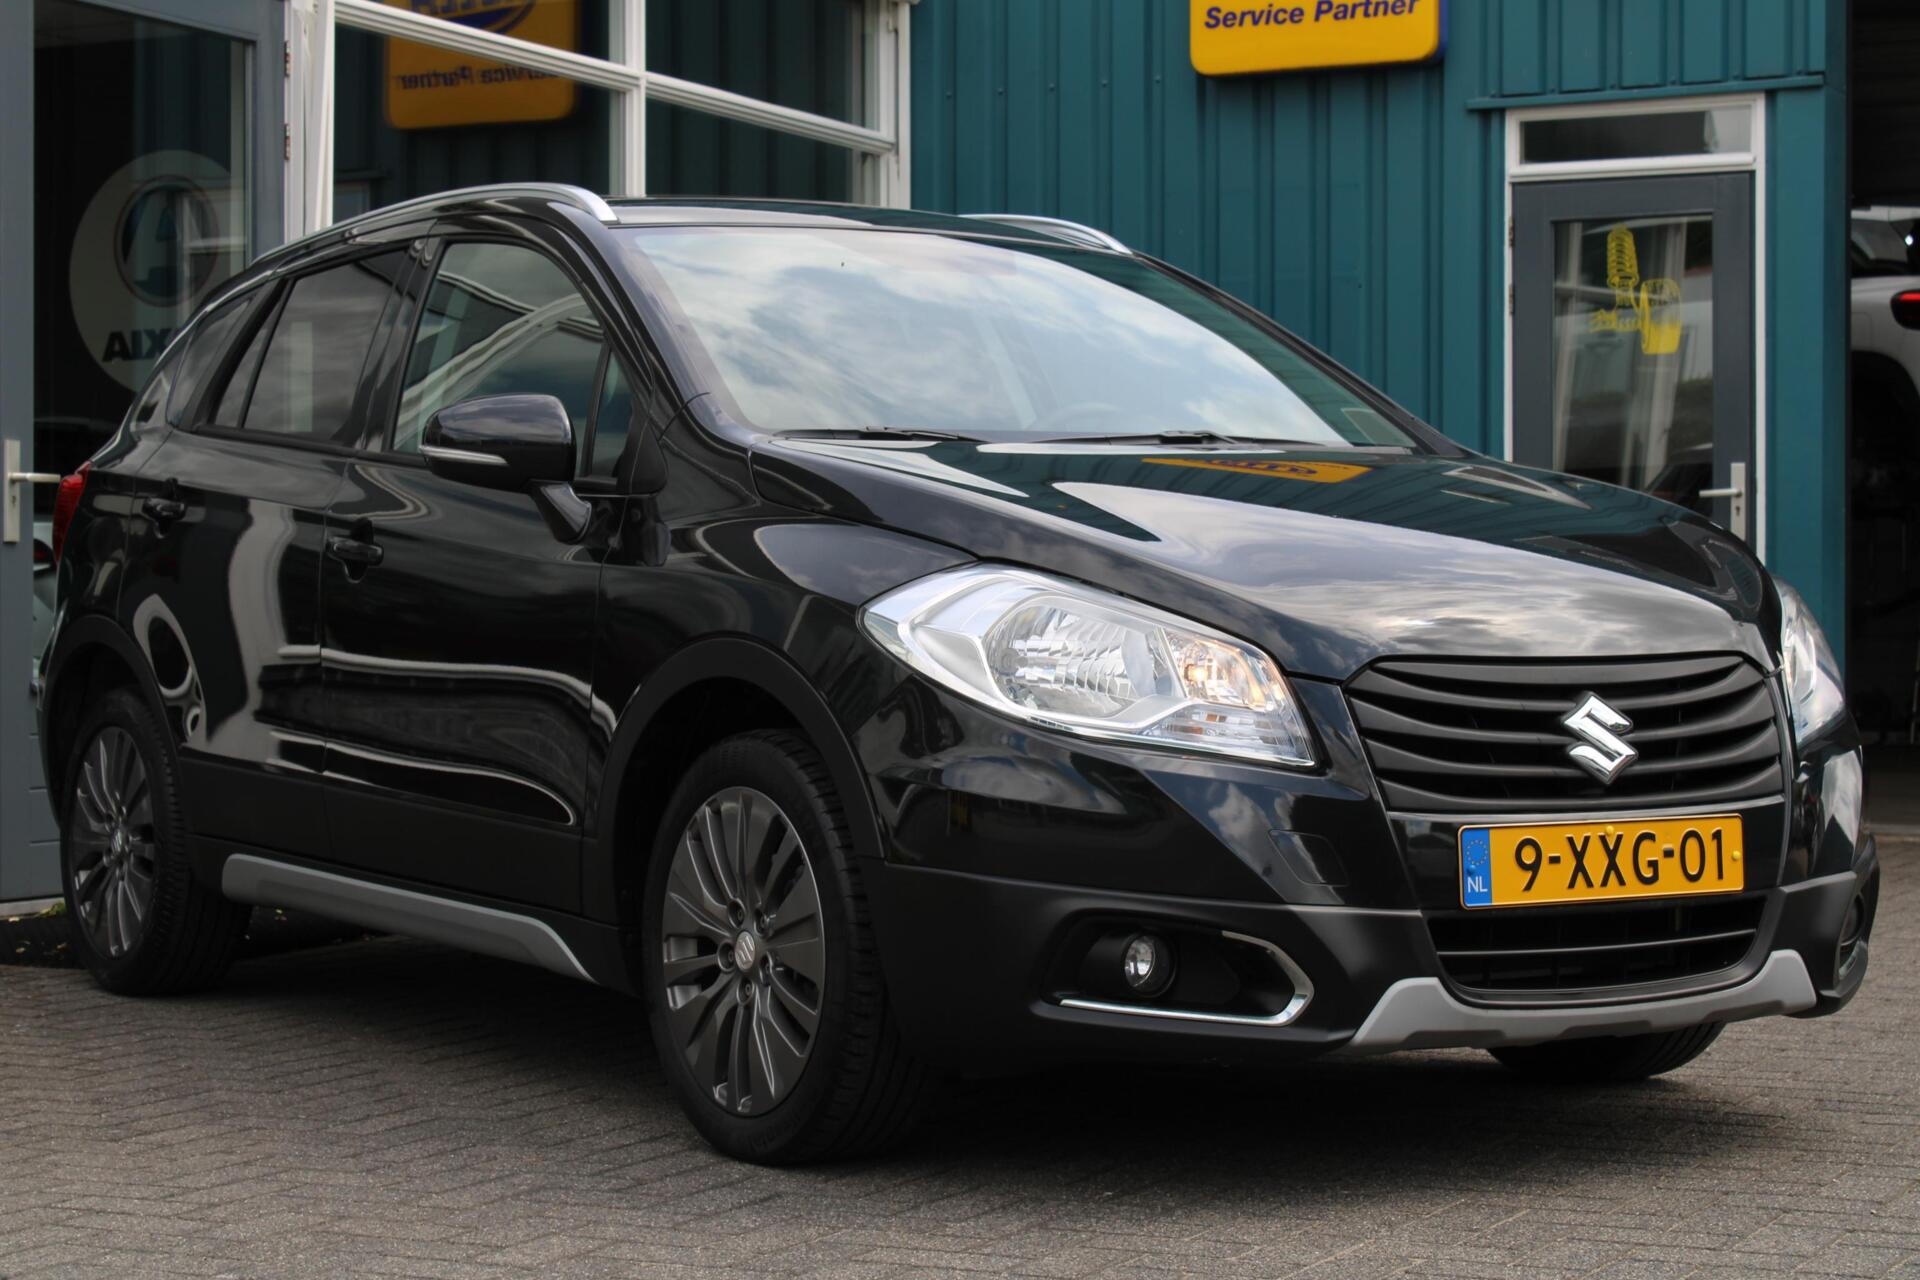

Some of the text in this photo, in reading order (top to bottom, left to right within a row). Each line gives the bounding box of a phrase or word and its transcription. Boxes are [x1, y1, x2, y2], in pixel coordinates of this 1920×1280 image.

[1204, 0, 1418, 29] Service Partner
[102, 328, 173, 362] AIX
[1513, 827, 1725, 893] 9-XXG-01
[1467, 875, 1488, 893] NL
